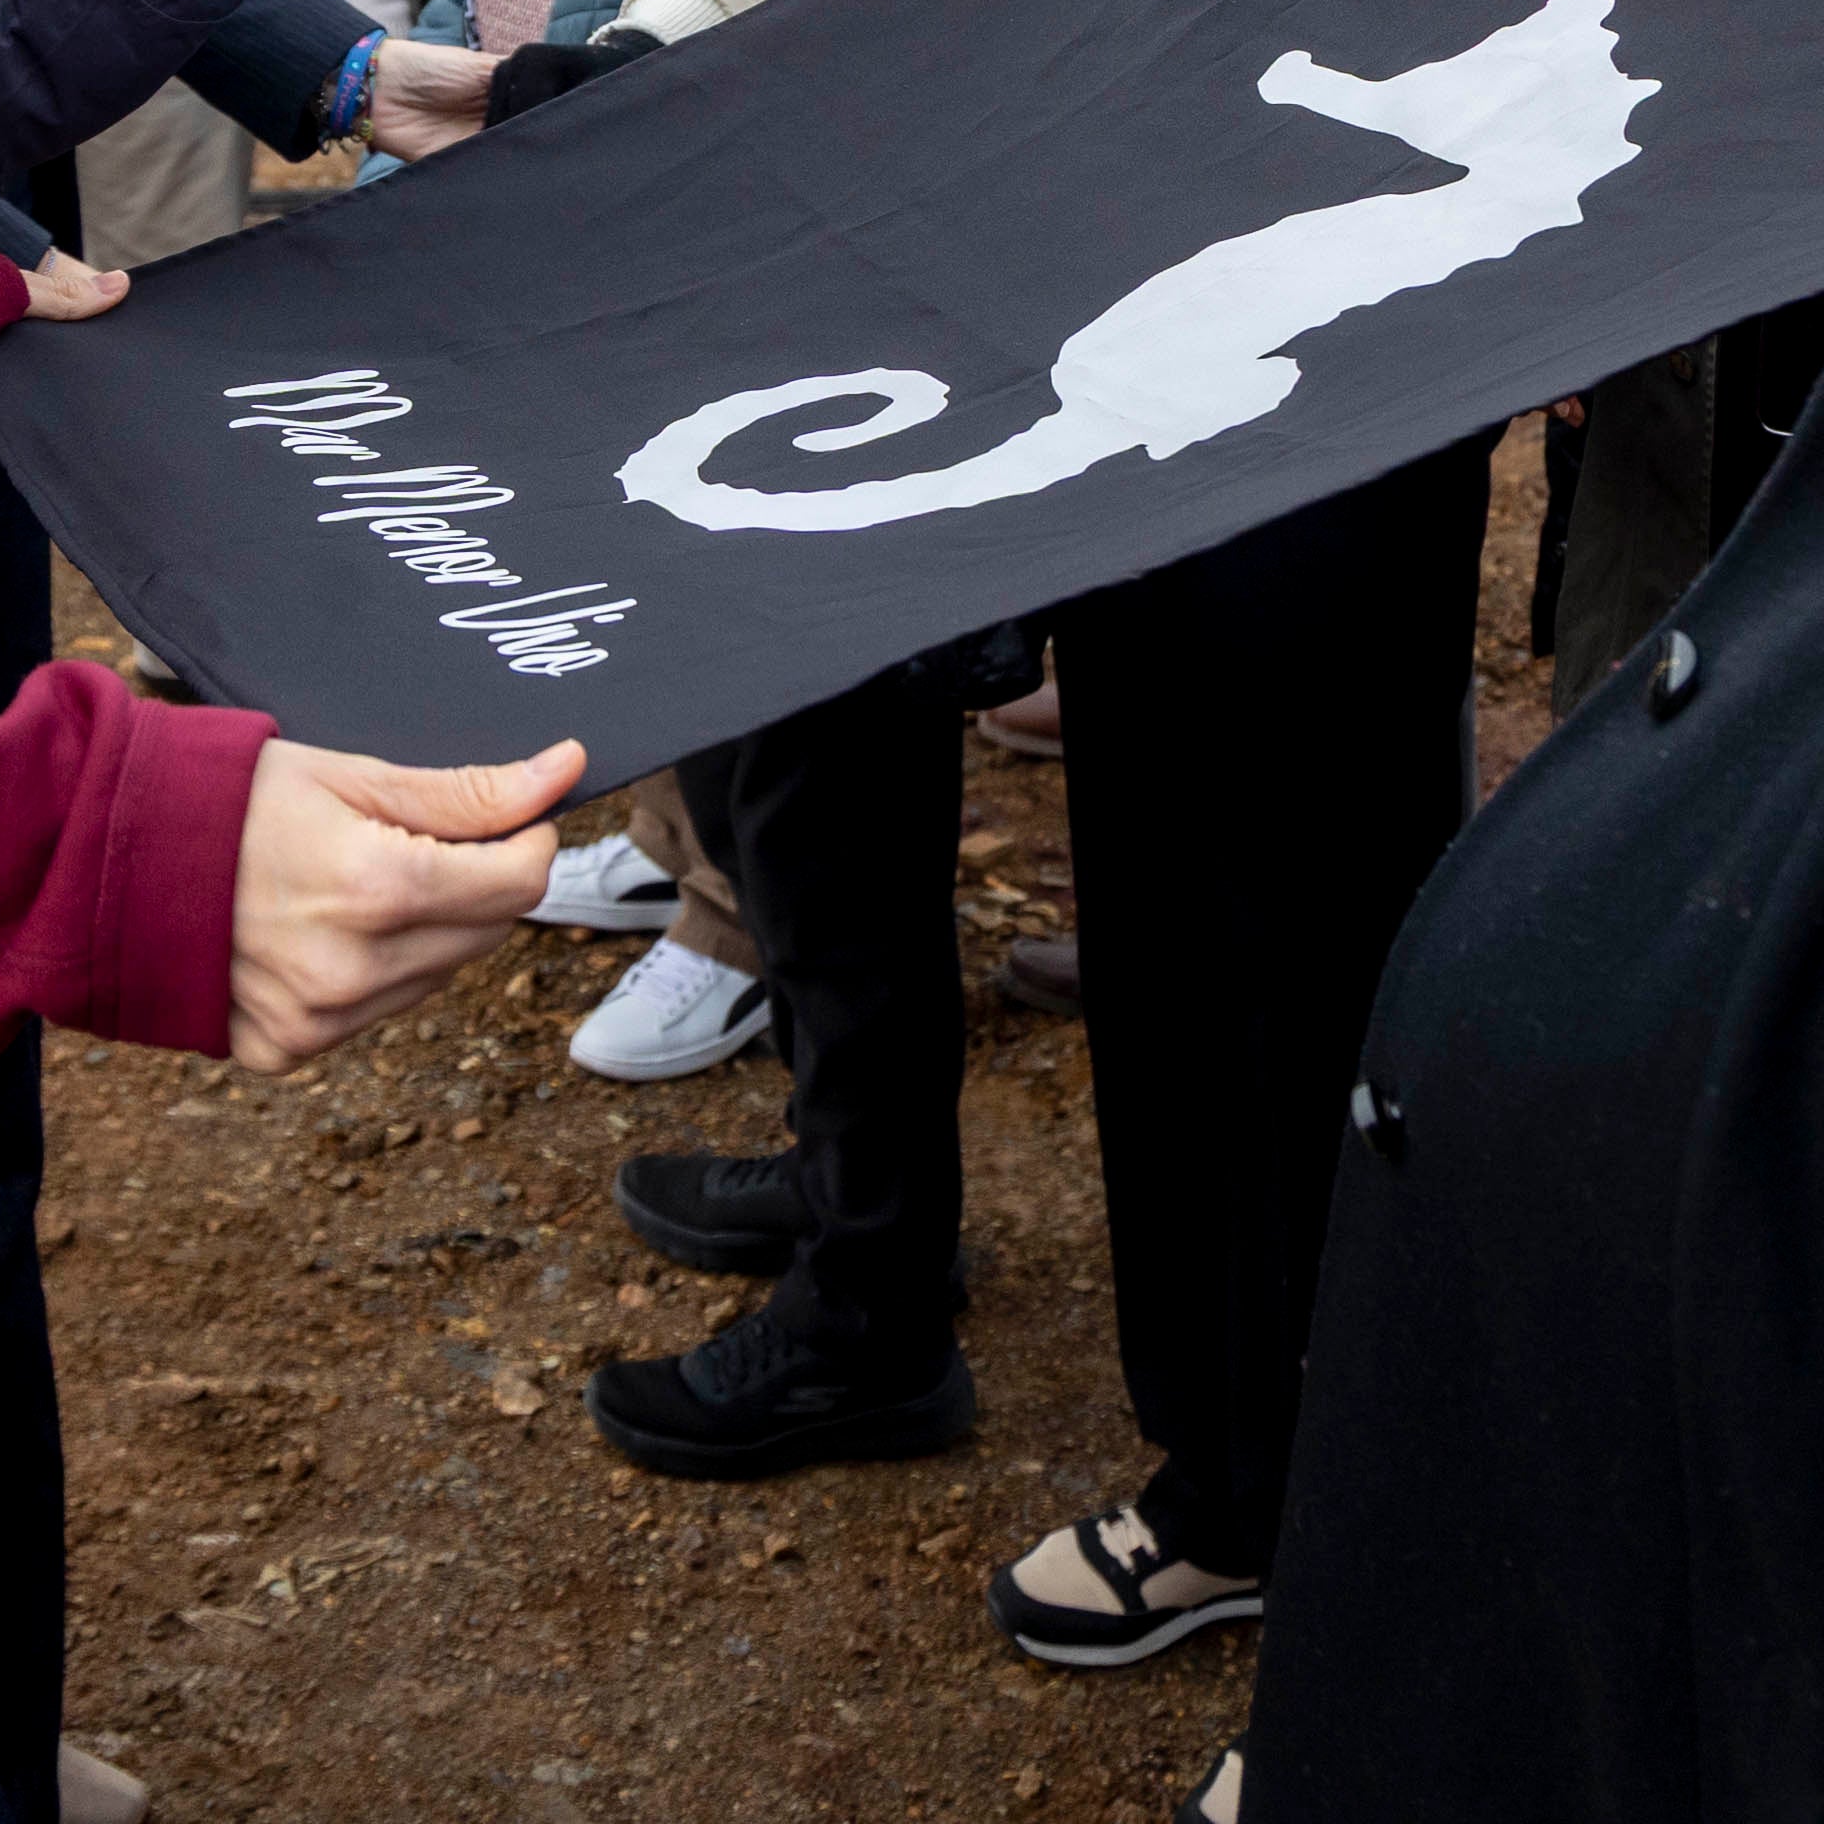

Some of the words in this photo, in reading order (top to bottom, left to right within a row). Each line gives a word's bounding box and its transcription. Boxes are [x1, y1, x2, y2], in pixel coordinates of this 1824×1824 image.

[223, 370, 413, 461] Mar
[313, 465, 522, 587] Menor
[439, 582, 637, 677] Vivo
